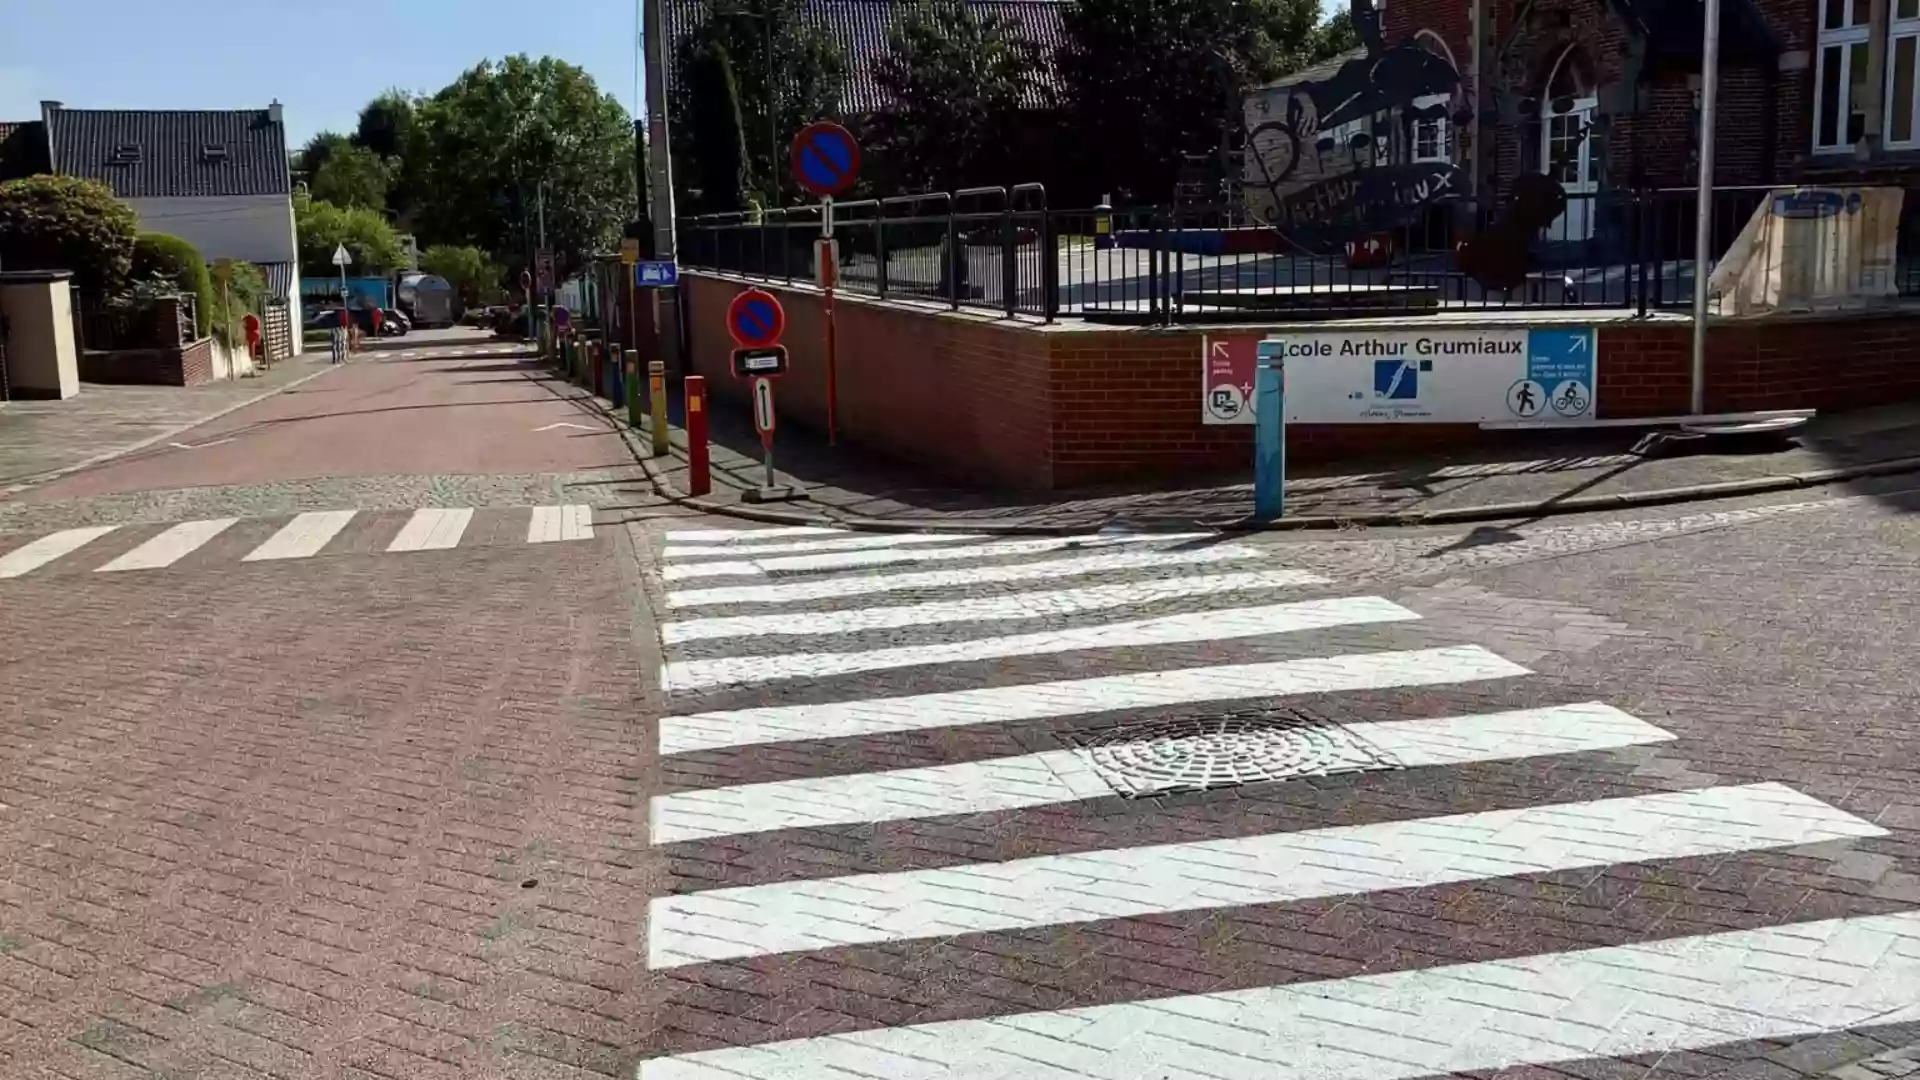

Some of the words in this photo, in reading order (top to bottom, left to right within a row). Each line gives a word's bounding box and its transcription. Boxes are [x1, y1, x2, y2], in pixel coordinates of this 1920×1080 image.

[1284, 339, 1332, 357] cole
[1339, 338, 1408, 356] Arthur
[1415, 337, 1522, 355] Grumiaux
